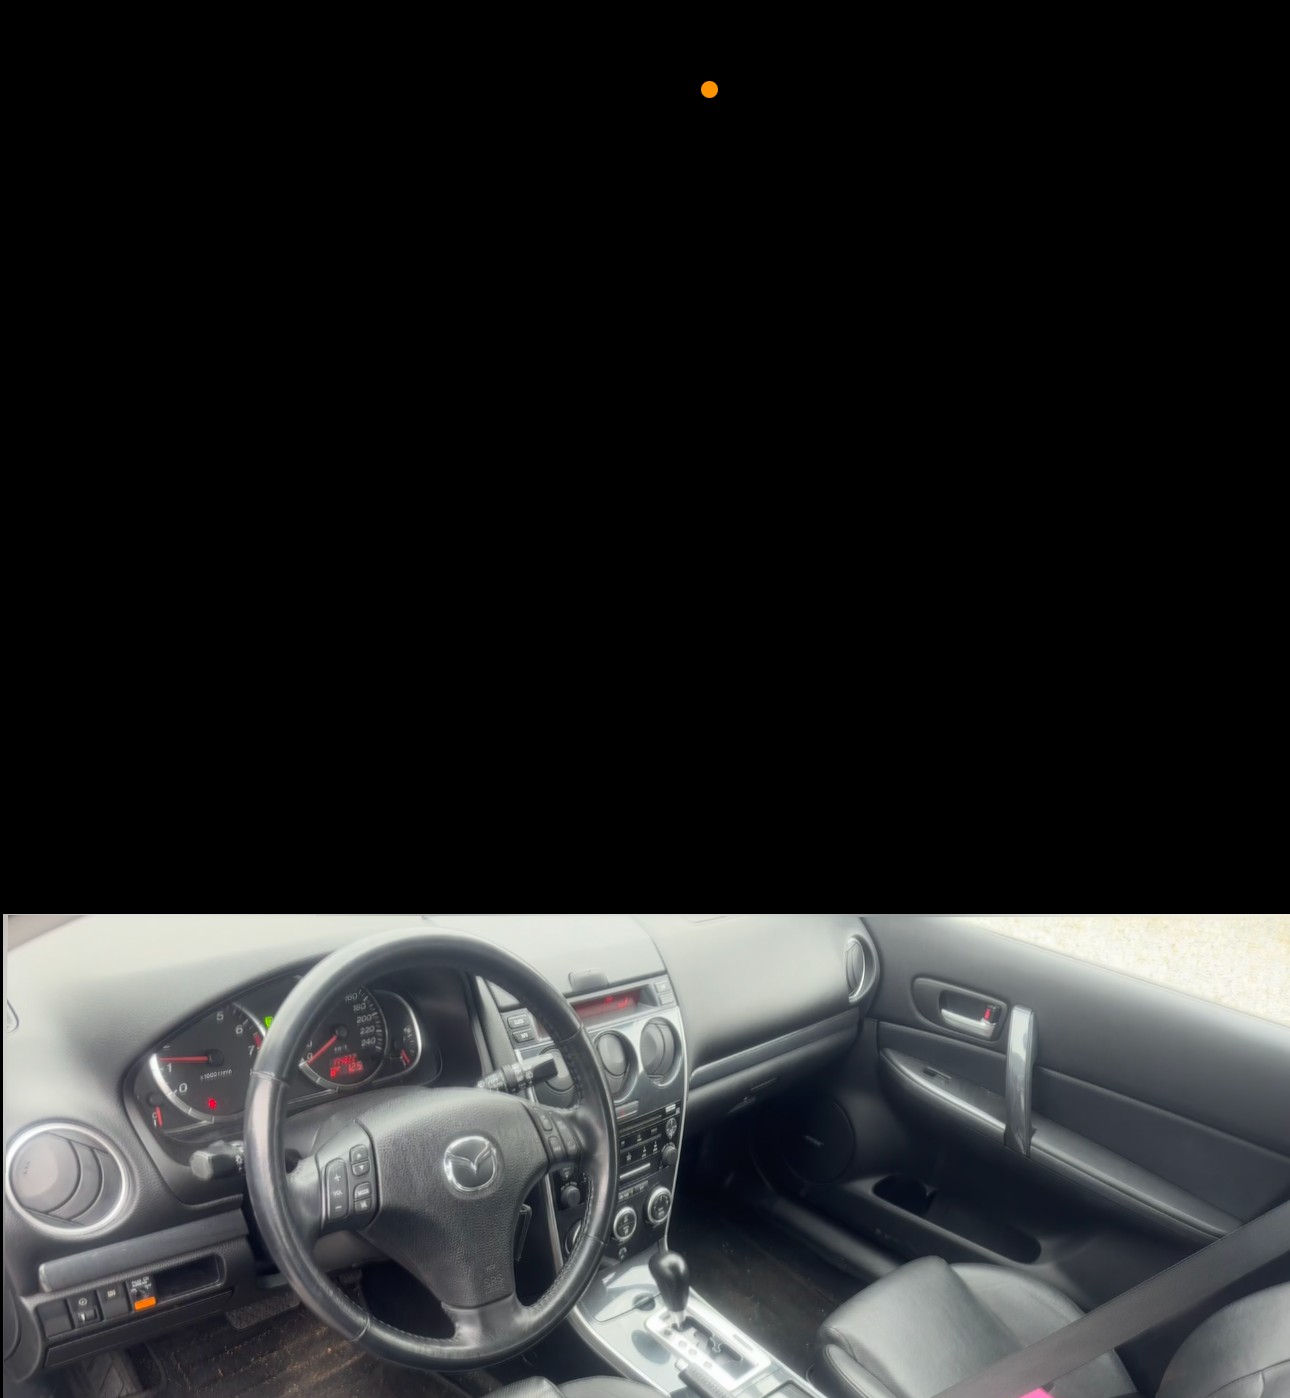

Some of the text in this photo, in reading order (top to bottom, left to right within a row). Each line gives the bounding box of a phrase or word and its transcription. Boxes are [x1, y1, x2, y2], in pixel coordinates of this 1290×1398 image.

[353, 1002, 366, 1011] 180
[216, 1011, 224, 1020] 5
[357, 1014, 372, 1024] 200
[235, 1025, 243, 1035] 6
[360, 1025, 375, 1035] 220
[361, 1037, 376, 1047] 240
[248, 1045, 255, 1055] 7
[167, 1062, 172, 1073] 1
[178, 1083, 188, 1093] 0
